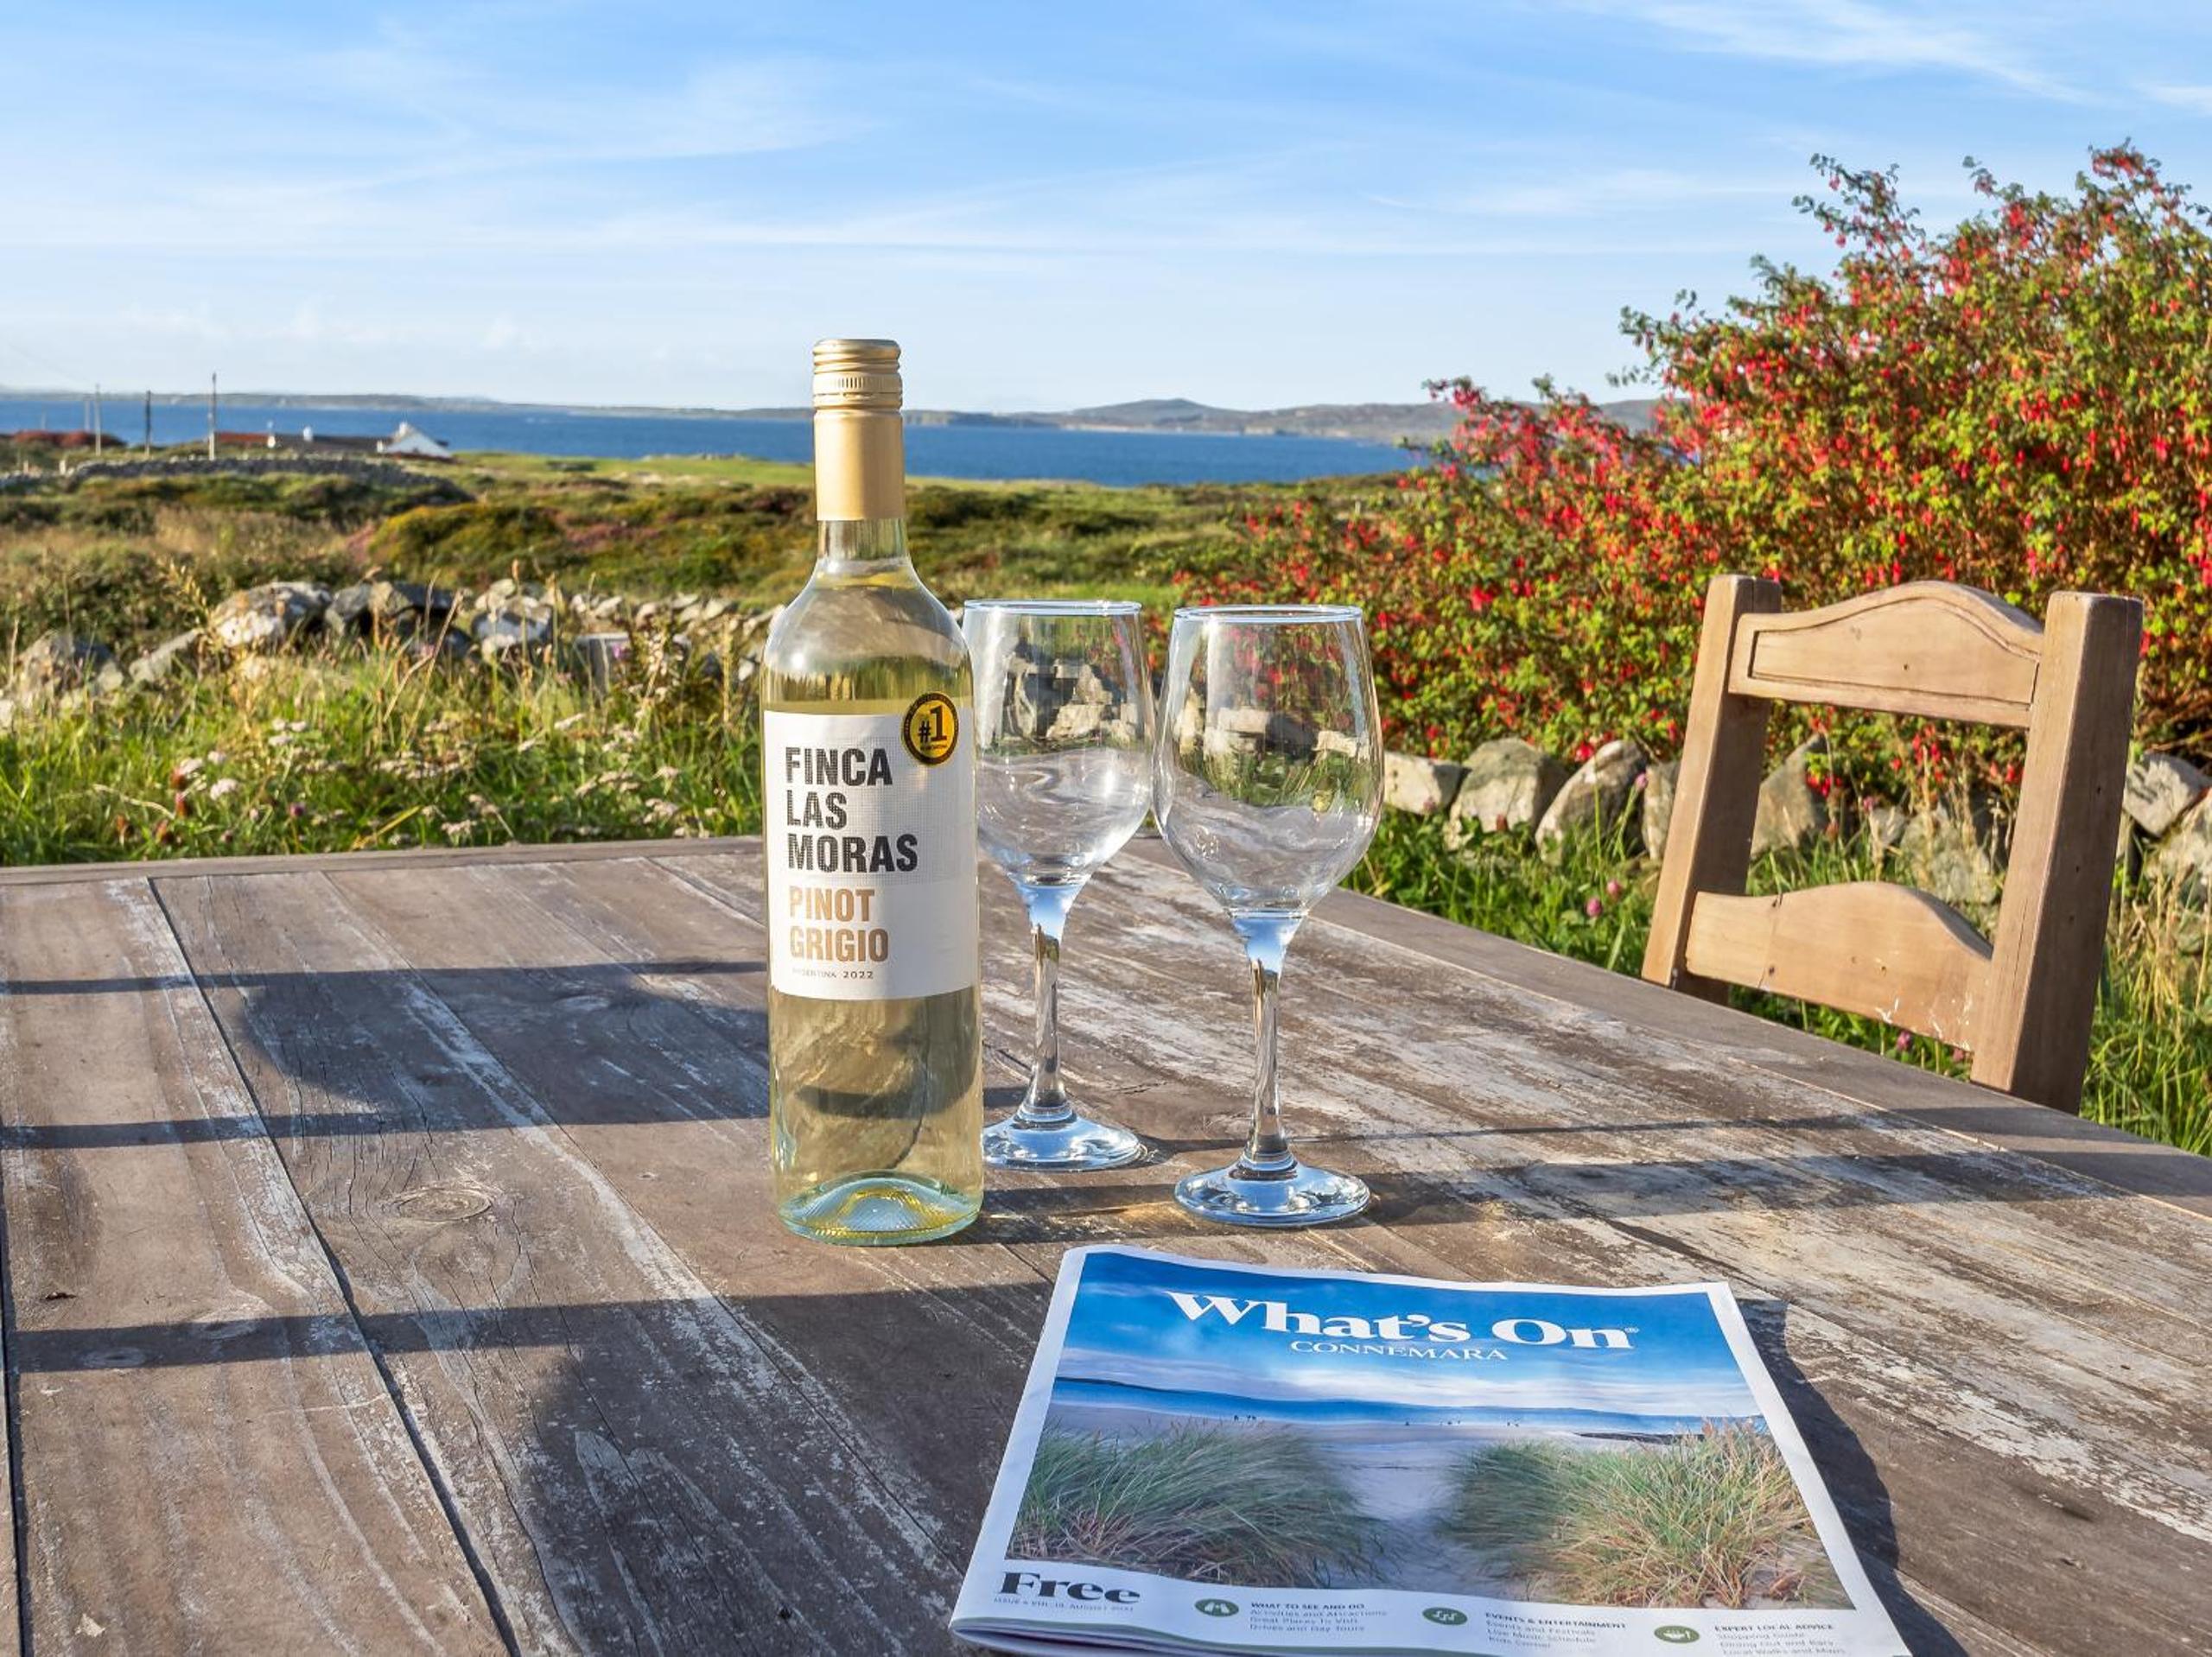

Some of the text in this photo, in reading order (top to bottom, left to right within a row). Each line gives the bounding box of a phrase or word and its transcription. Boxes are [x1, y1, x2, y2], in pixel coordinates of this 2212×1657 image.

[785, 746, 893, 787] FINCA
[786, 790, 848, 830] LAS
[787, 833, 918, 873] MORAS
[789, 886, 875, 922] PINOT
[790, 925, 889, 962] GRIGIO
[843, 970, 874, 980] 2022
[1165, 1291, 1470, 1343] What's
[1291, 1340, 1508, 1361] CONNEMARA
[999, 1571, 1141, 1605] Free
[1485, 1612, 1525, 1623] EVENTS
[1539, 1619, 1626, 1629] ENTERTAINMENT
